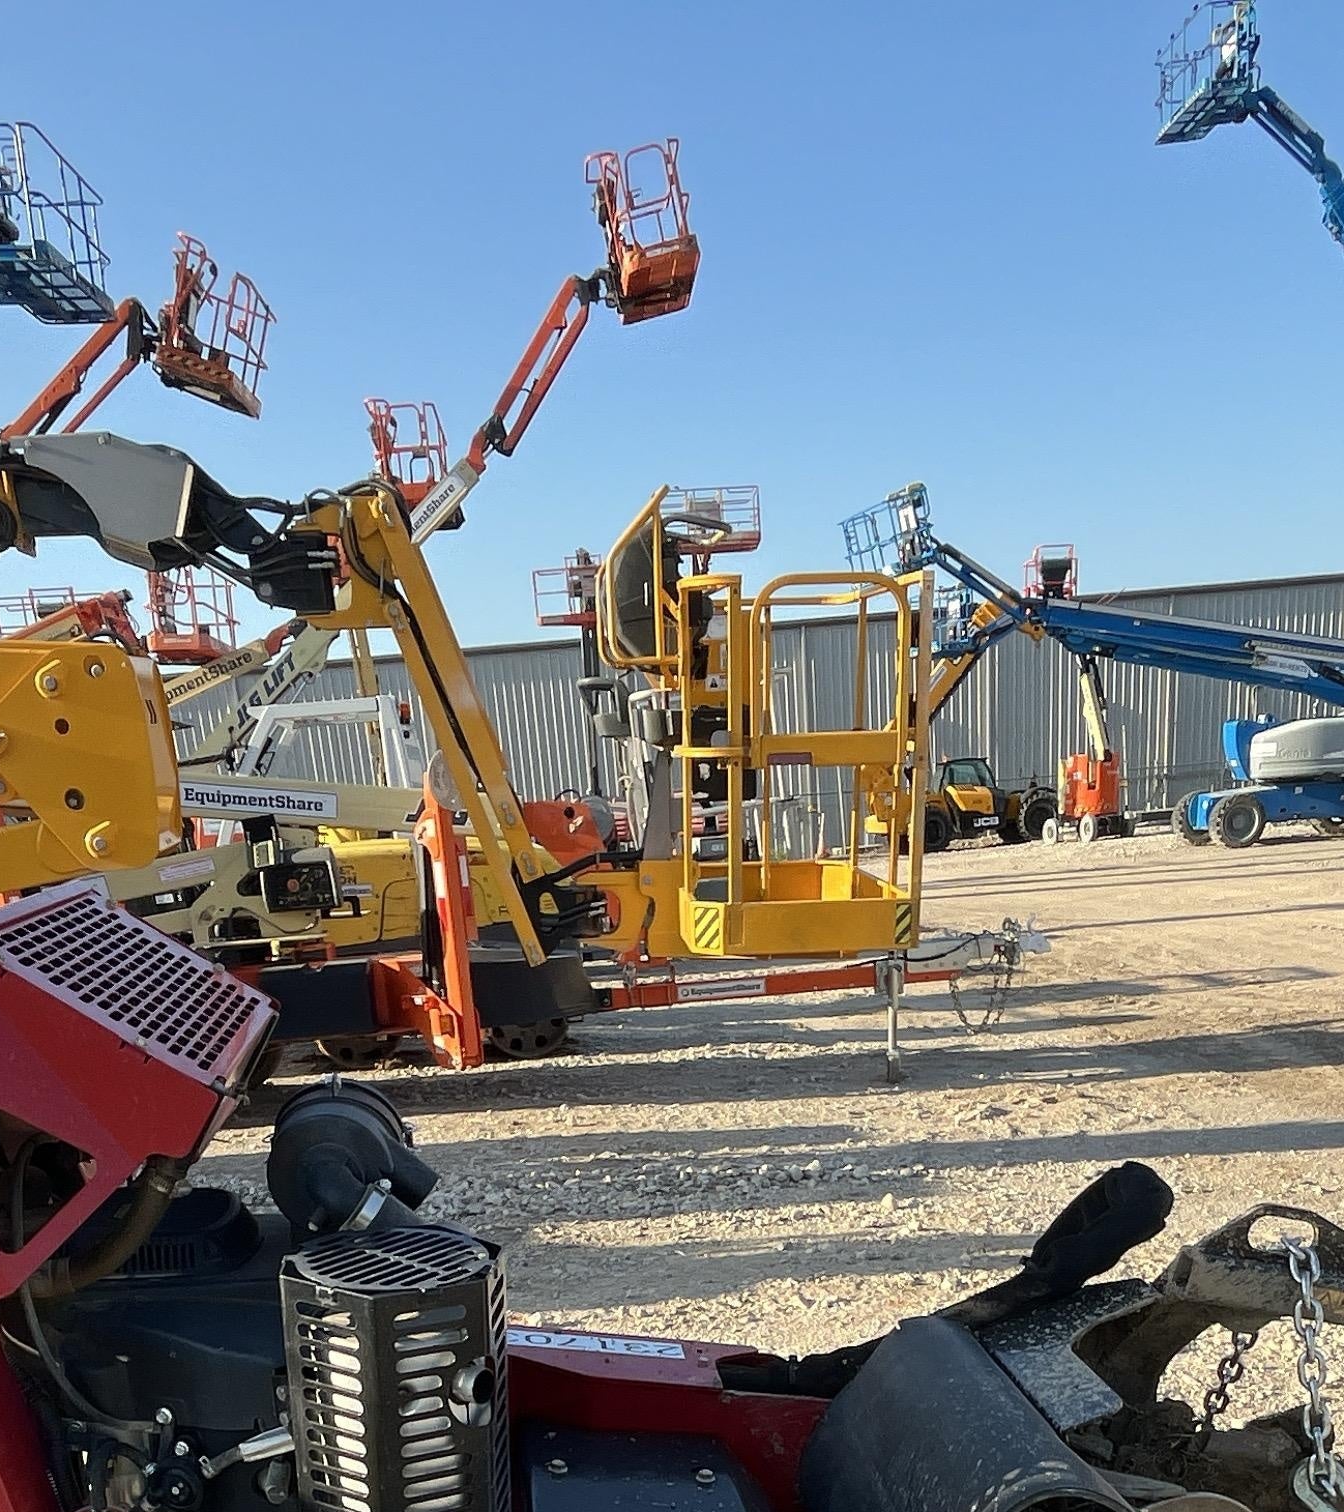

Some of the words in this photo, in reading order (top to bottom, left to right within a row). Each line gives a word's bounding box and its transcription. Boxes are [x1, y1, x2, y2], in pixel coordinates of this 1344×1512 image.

[412, 483, 456, 534] entShare
[165, 652, 253, 704] pmentShare
[263, 651, 297, 698] LIFT
[183, 787, 324, 812] EquipmentShare
[973, 815, 1000, 828] JCB
